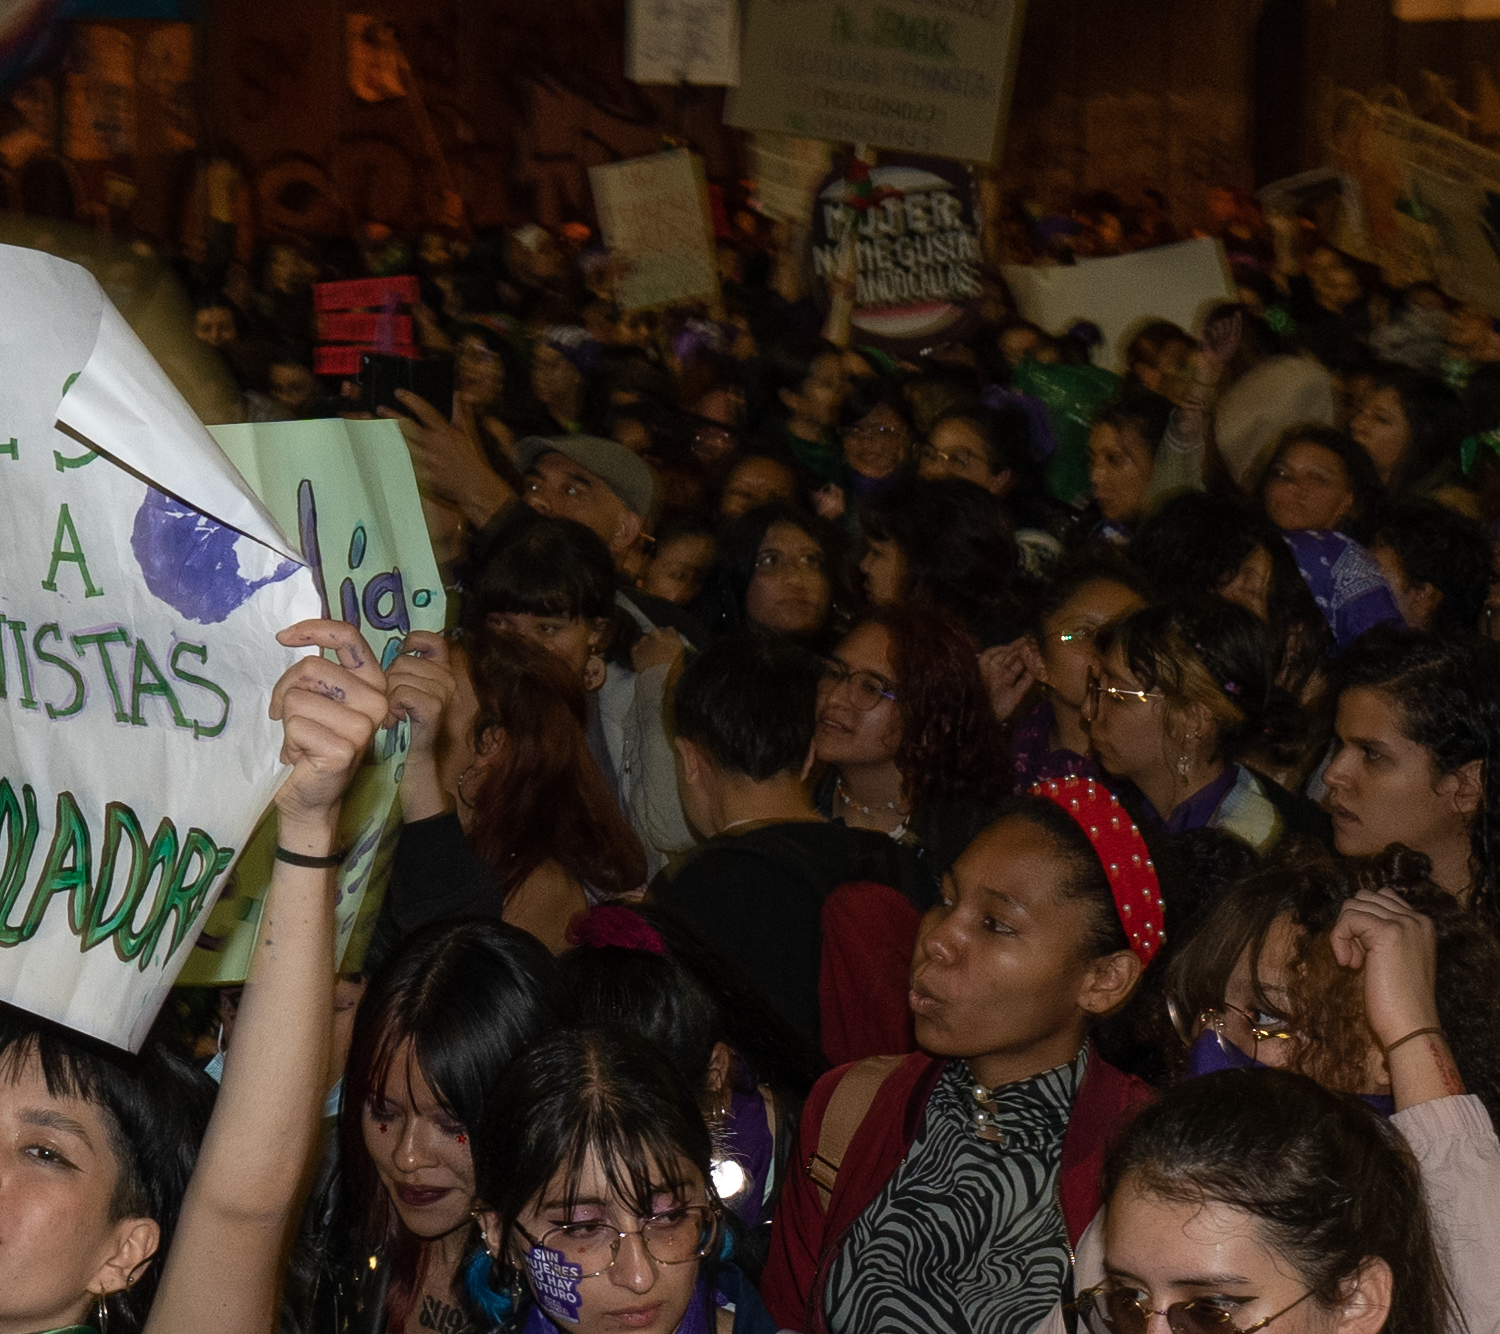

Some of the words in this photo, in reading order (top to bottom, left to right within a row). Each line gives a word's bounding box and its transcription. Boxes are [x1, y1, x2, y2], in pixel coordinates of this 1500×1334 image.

[40, 502, 105, 598] A
[534, 1279, 578, 1305] UTURO
[546, 1274, 574, 1292] HAY
